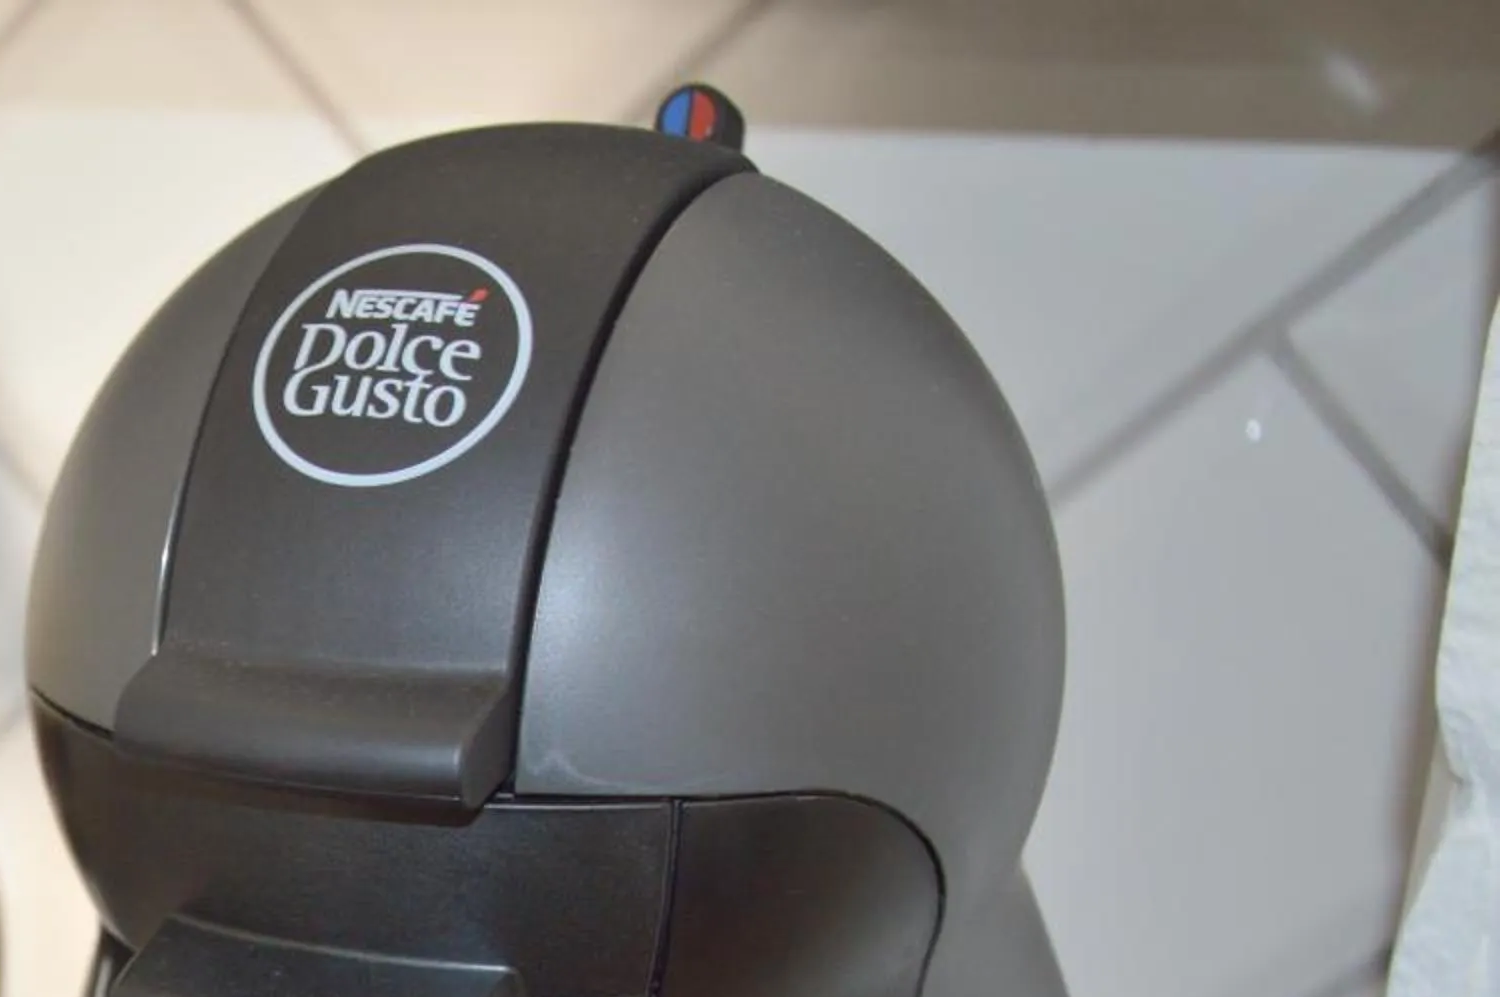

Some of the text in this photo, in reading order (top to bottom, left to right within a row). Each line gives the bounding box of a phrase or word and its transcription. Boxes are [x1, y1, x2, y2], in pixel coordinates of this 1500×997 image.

[325, 288, 489, 328] NESCAFÉ
[293, 322, 482, 381] Dolce
[283, 367, 467, 428] Gusto
